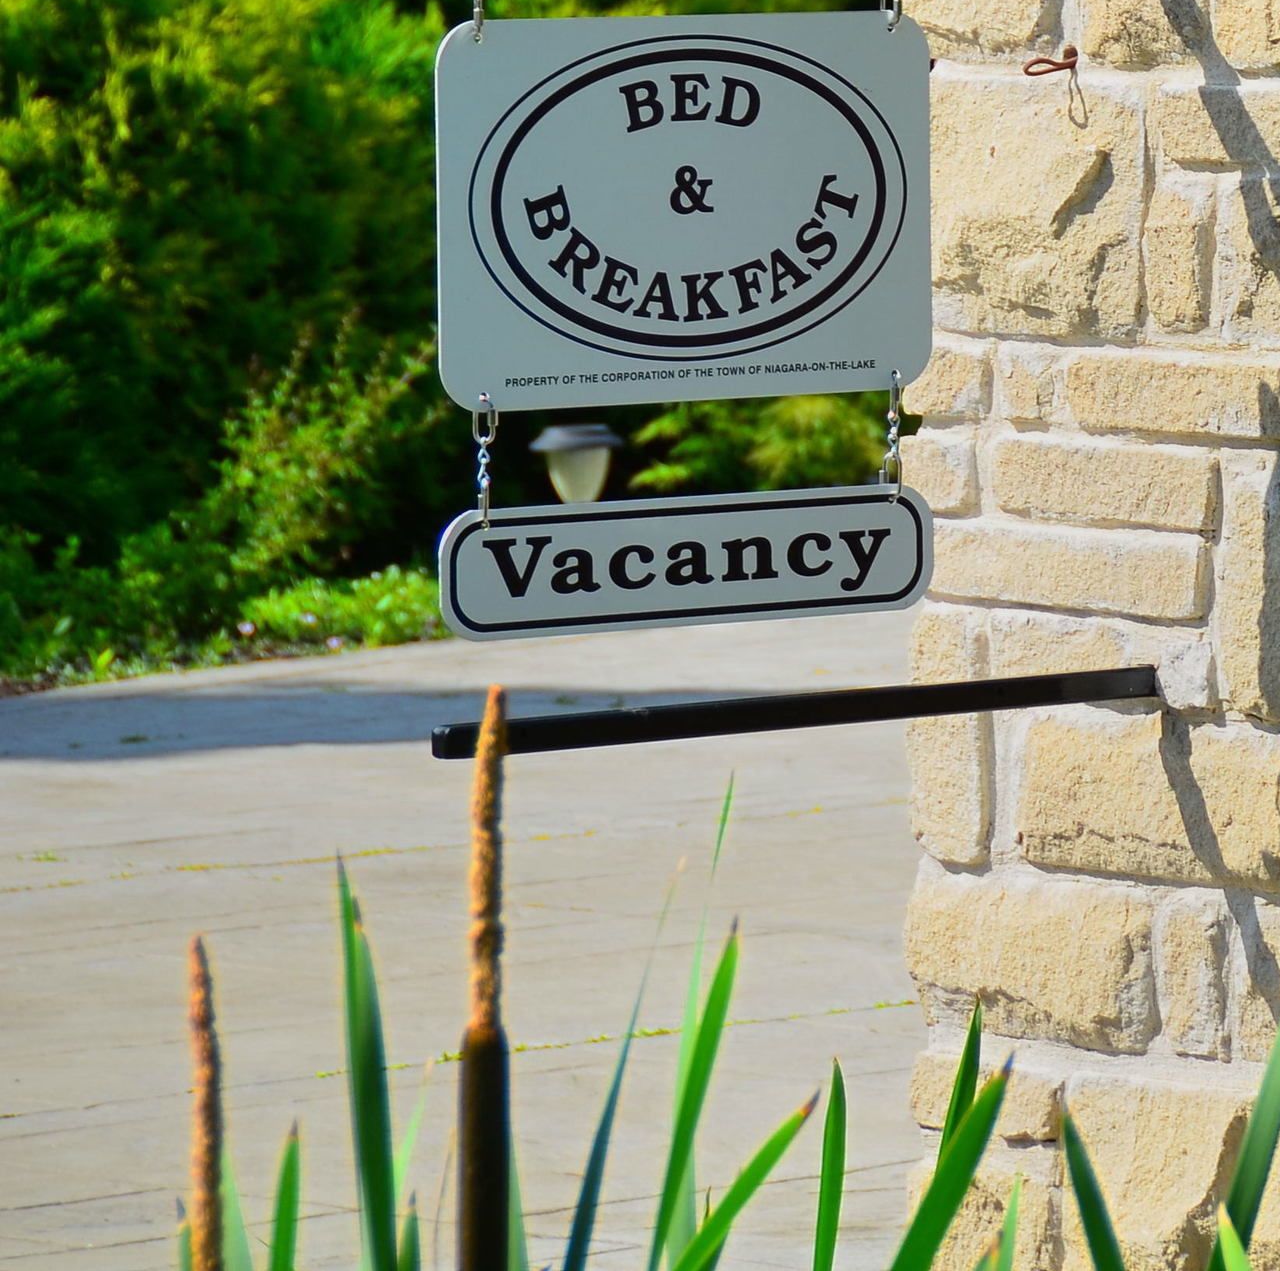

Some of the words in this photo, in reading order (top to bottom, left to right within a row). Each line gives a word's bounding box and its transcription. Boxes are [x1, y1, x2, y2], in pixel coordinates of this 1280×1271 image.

[618, 72, 762, 133] BED
[669, 165, 714, 215] &
[523, 174, 860, 323] BREAKFAST
[504, 376, 560, 388] PROPERTY
[562, 375, 576, 385] OF
[579, 373, 599, 384] THE
[601, 370, 675, 383] CORPORATION
[678, 369, 692, 378] OF
[695, 367, 713, 378] THE
[717, 366, 746, 376] TOWN
[749, 365, 762, 375] OF
[764, 359, 876, 374] NIAGARA-ON-THE-LAKE
[482, 527, 892, 599] Vacancy
